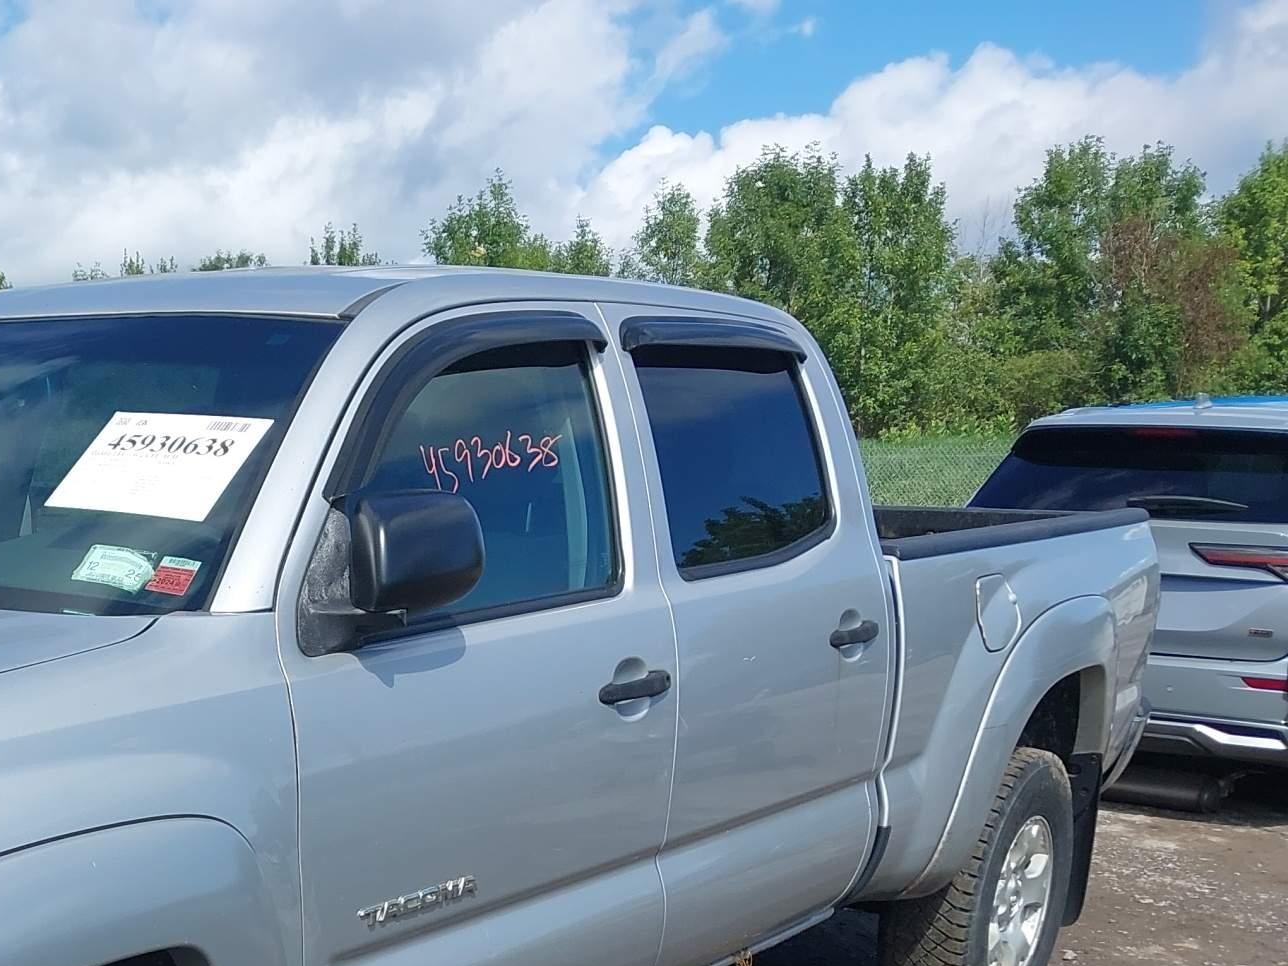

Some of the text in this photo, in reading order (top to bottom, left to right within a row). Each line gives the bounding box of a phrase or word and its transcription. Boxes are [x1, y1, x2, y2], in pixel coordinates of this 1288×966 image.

[107, 432, 236, 457] 45930638
[420, 430, 562, 494] 45930638
[357, 875, 475, 927] TACOMA
